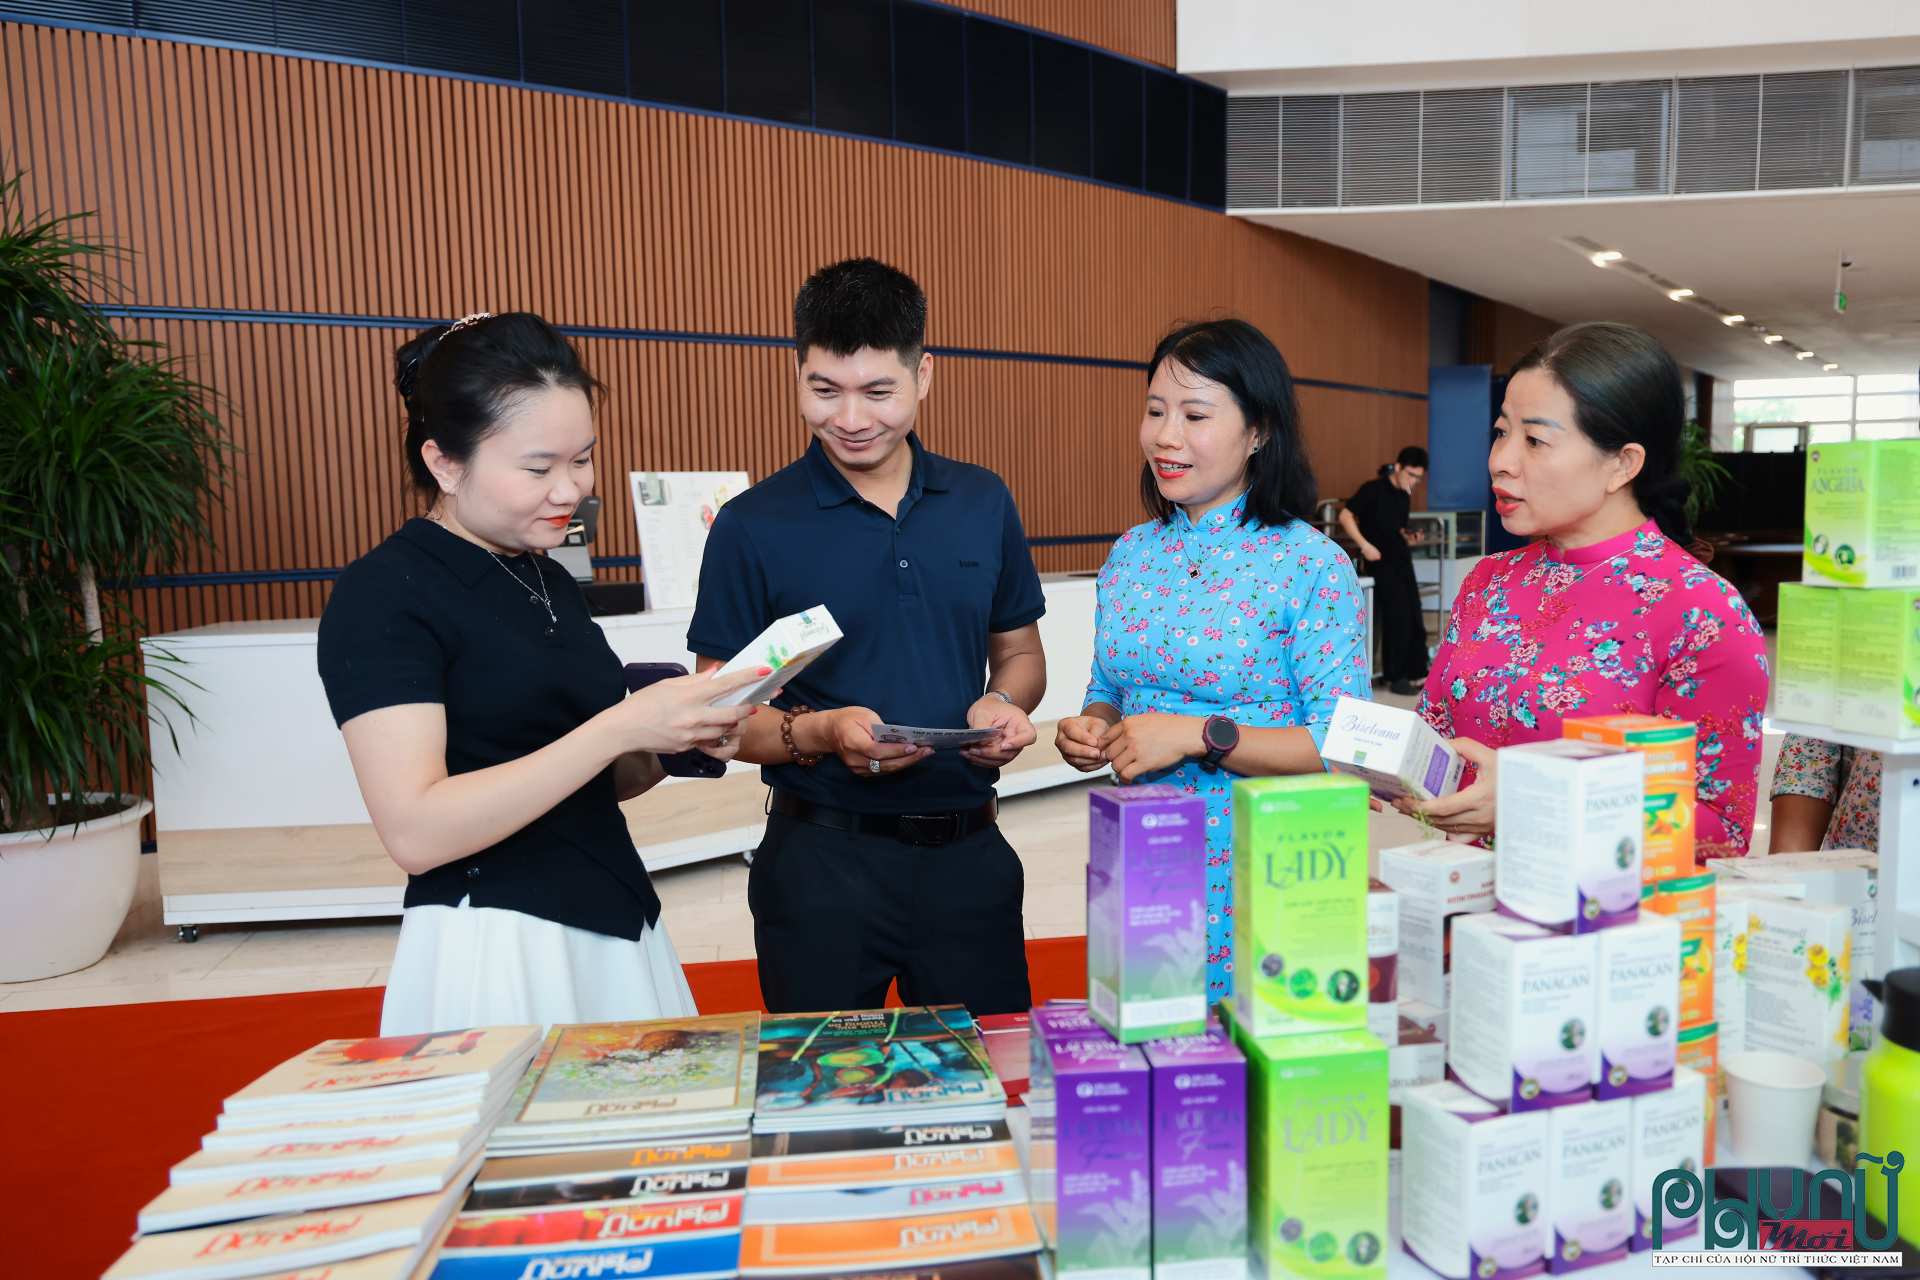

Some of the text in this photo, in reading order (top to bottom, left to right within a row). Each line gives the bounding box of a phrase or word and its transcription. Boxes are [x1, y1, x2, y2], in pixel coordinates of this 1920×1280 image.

[1340, 714, 1401, 740] Biscleana
[1585, 790, 1640, 813] PANACAN
[1264, 842, 1355, 890] LADY
[1522, 972, 1591, 995] PANACAN
[1610, 961, 1675, 983] PANACAN
[1283, 1105, 1377, 1155] LADY
[1643, 1112, 1702, 1139] PANACAN
[1562, 1132, 1627, 1160] PANACAN
[1477, 1147, 1543, 1176] PANACAN
